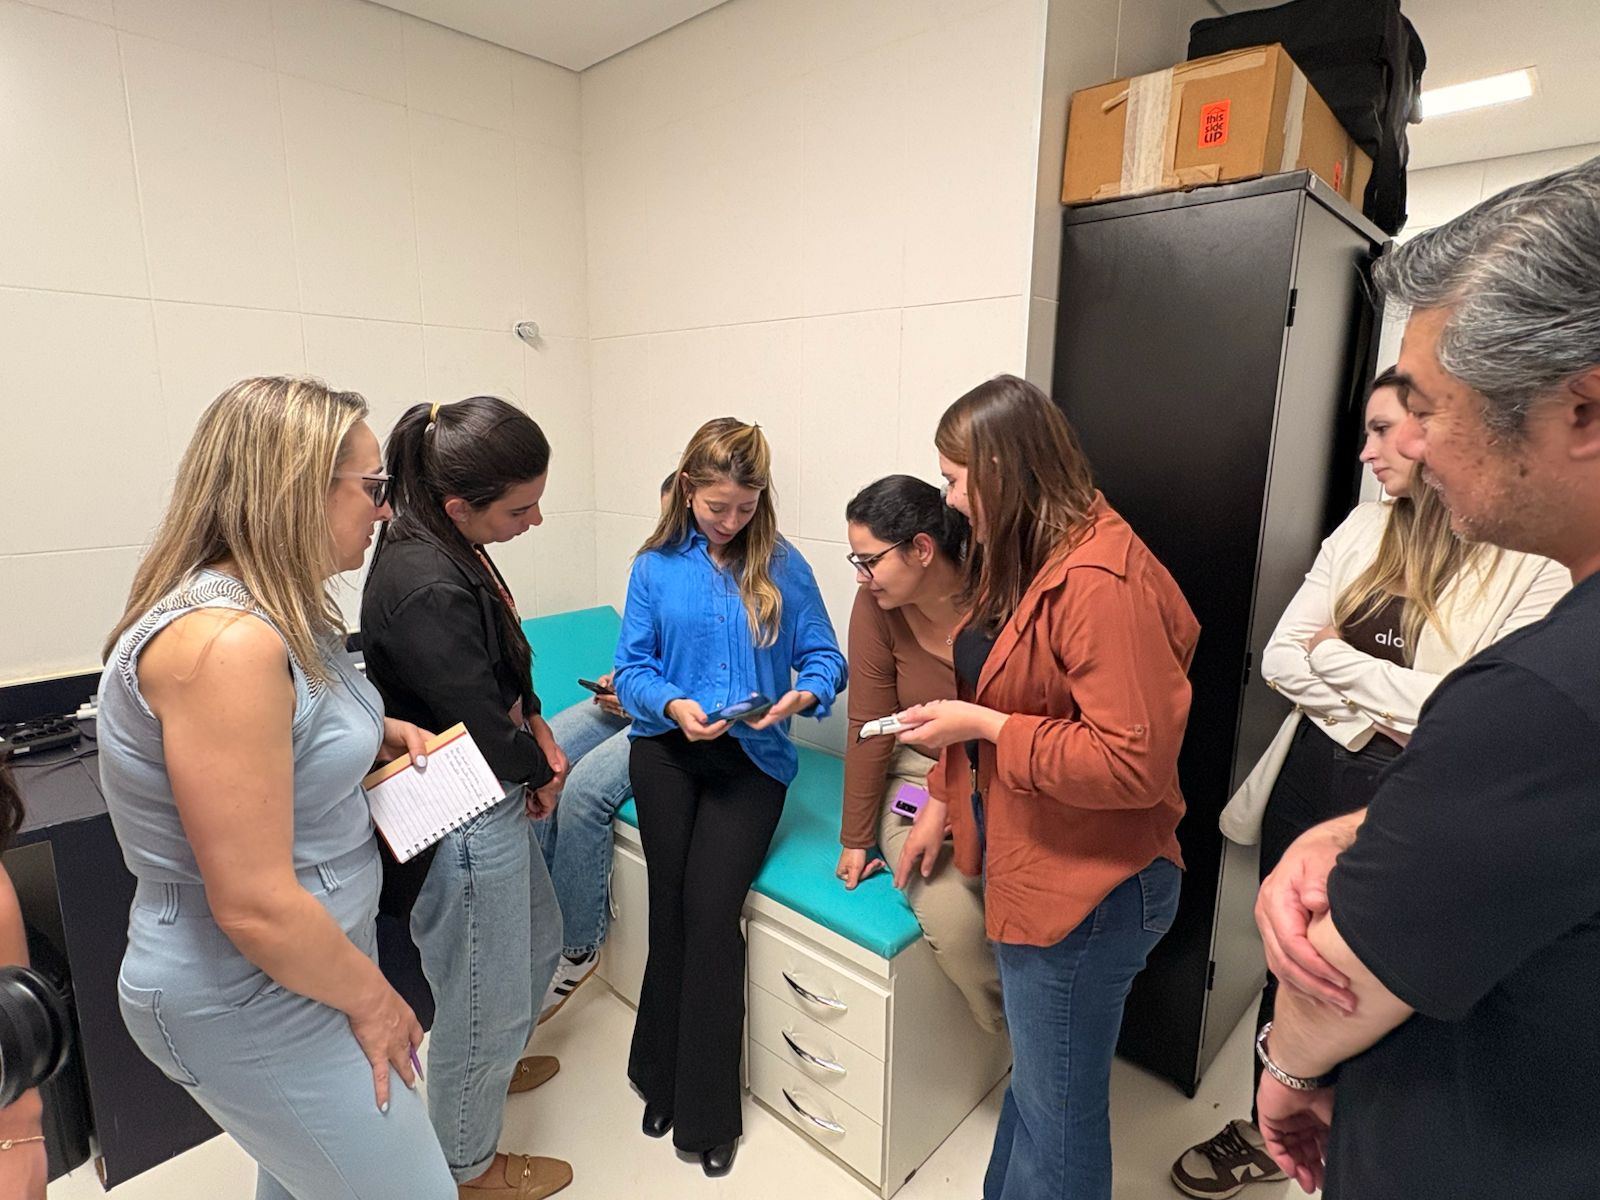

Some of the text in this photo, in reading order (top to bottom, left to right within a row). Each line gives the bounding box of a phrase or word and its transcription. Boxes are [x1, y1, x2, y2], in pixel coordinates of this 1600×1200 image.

[1206, 113, 1223, 124] this
[1205, 122, 1223, 133] side
[1204, 131, 1223, 143] UP
[1375, 628, 1405, 648] alo
